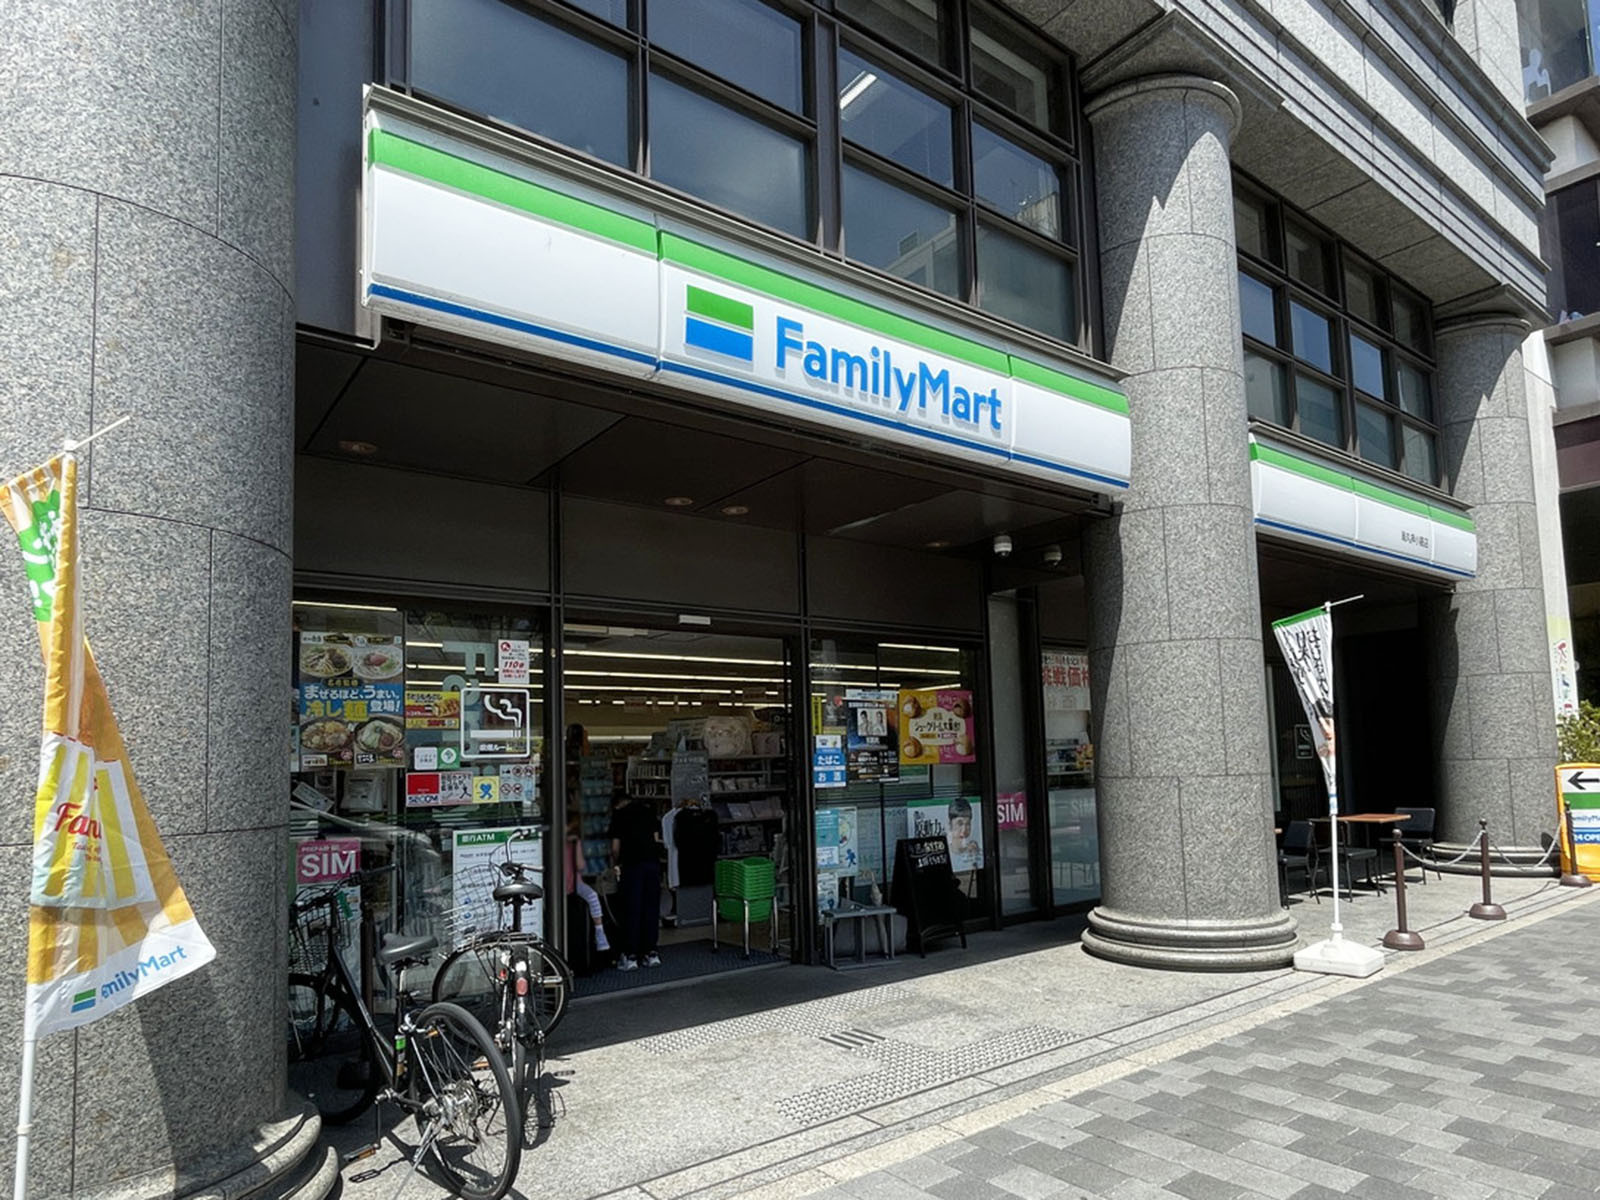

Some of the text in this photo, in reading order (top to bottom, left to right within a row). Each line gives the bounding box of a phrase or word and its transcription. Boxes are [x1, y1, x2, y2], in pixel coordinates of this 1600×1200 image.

[775, 316, 1003, 432] FamilyMart
[817, 755, 841, 765] たばこ
[996, 802, 1025, 824] SIM
[301, 850, 356, 877] SIM
